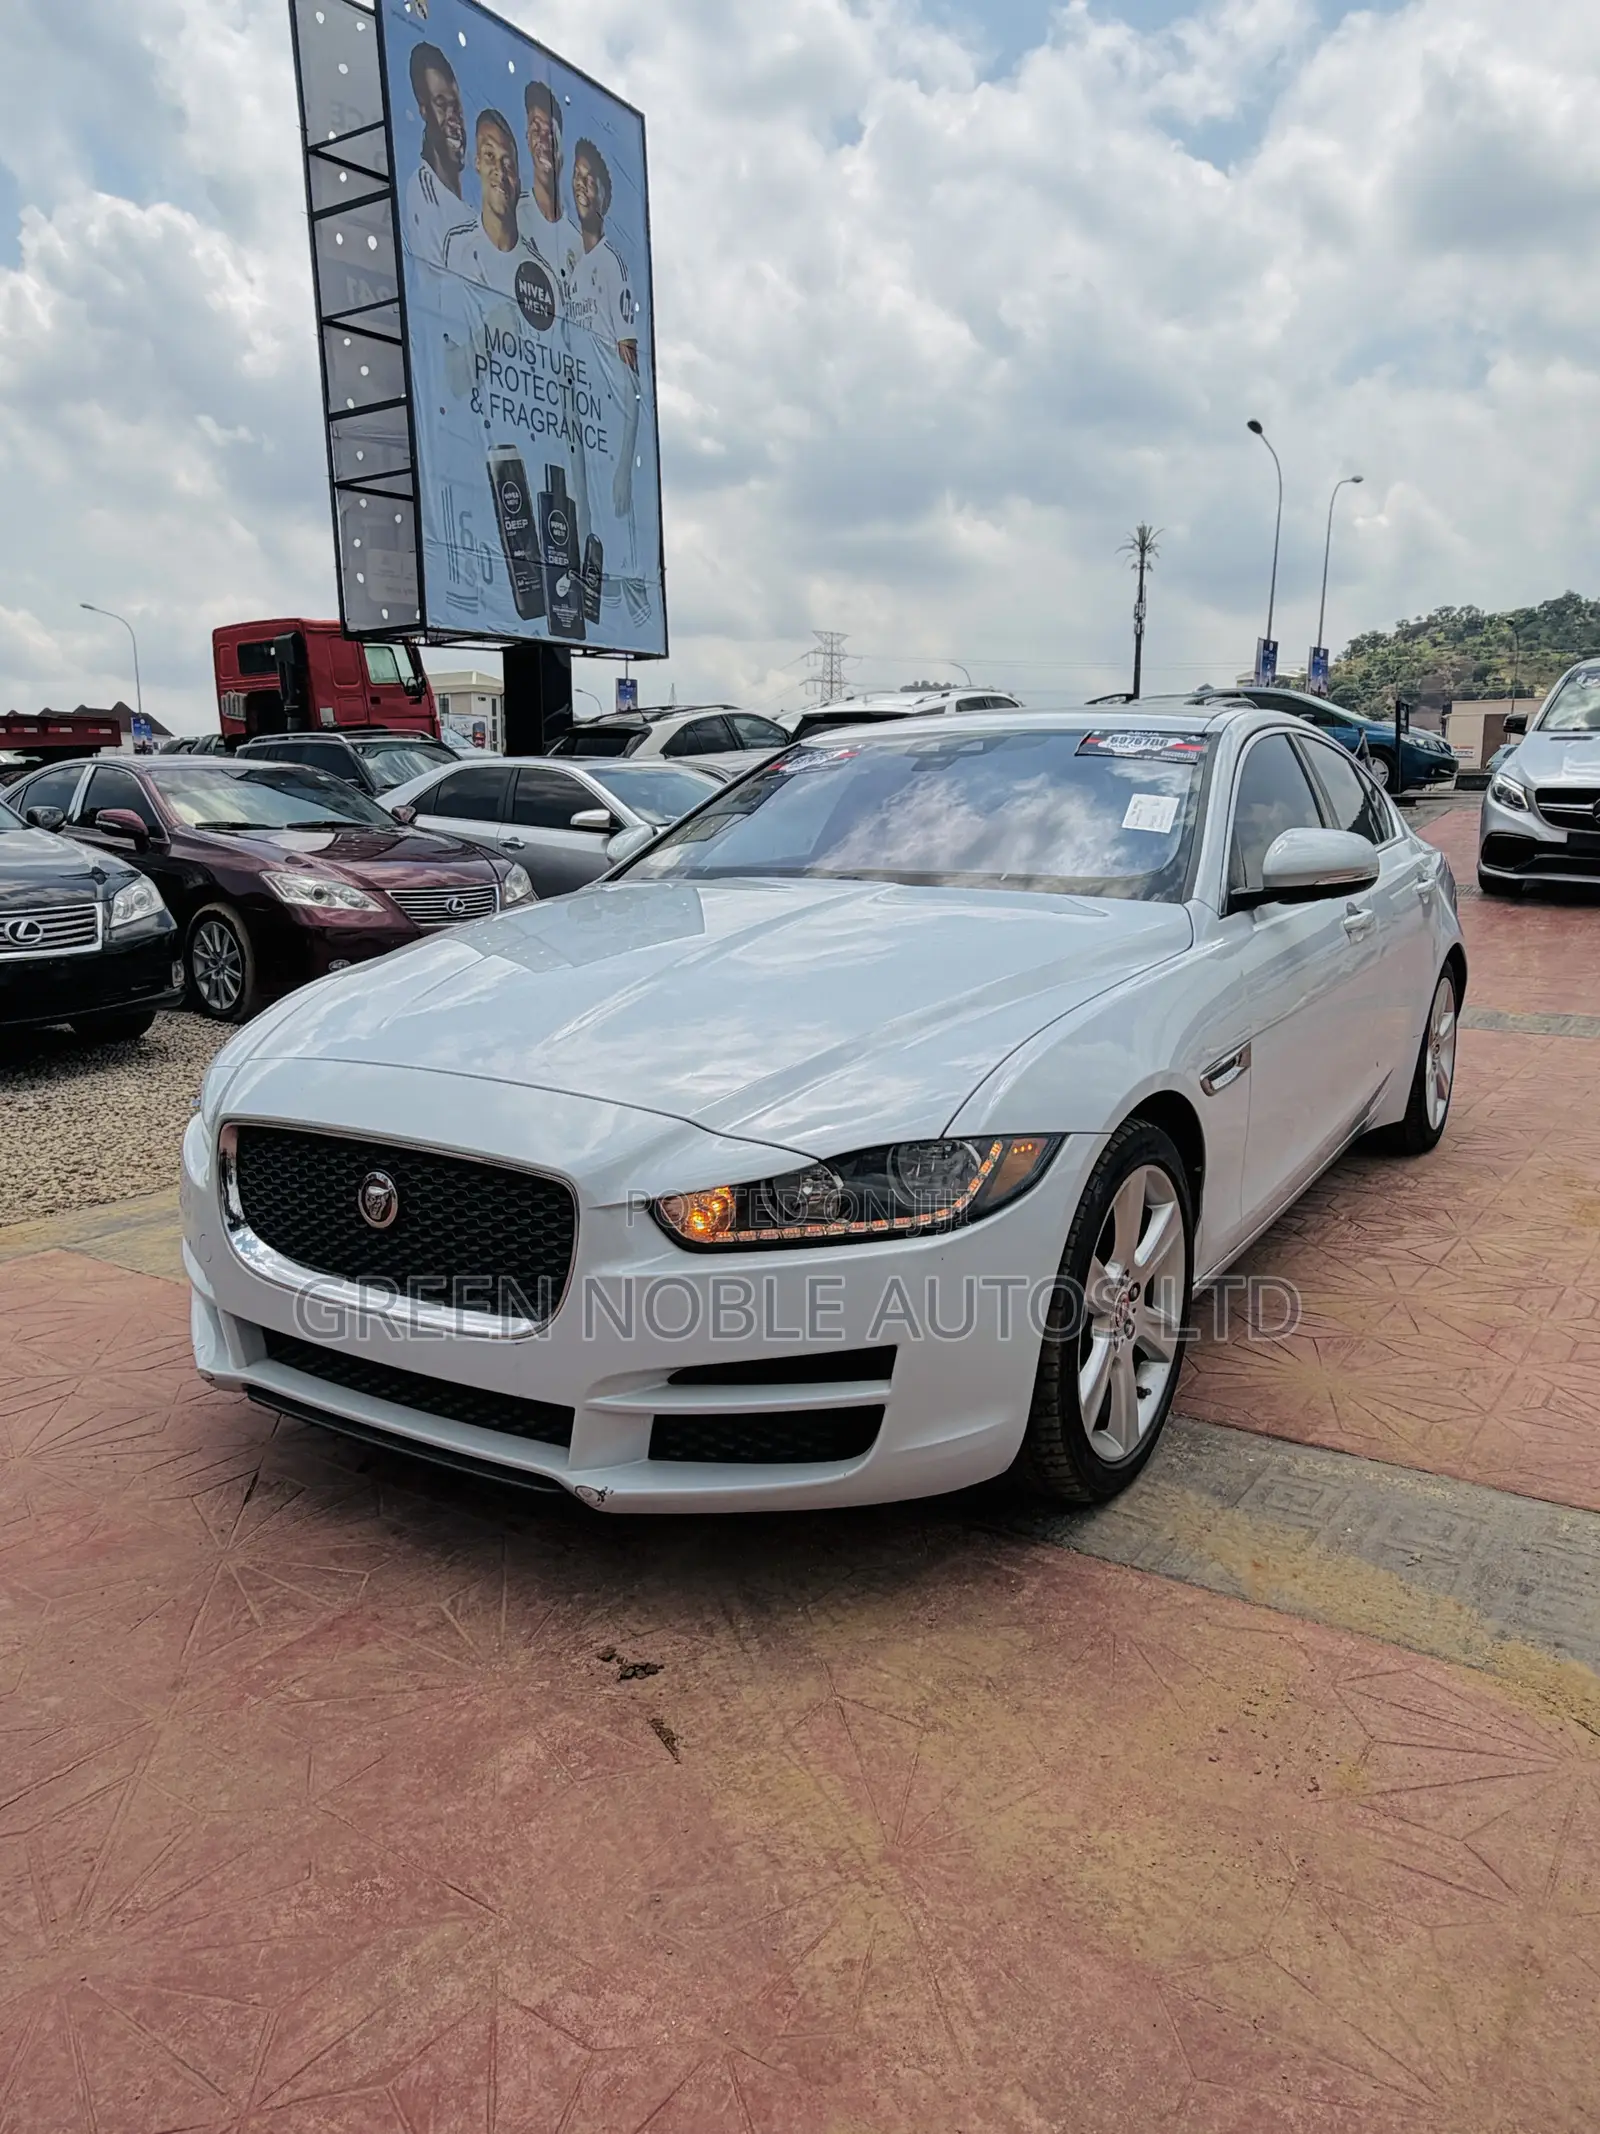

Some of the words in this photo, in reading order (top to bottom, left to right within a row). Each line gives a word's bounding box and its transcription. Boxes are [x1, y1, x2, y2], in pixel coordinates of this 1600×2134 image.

[519, 278, 552, 306] NIVEA
[524, 297, 548, 317] MEN
[484, 323, 593, 391] MOISTURE,
[470, 387, 484, 415] &
[475, 353, 602, 421] PROTECTION
[504, 518, 529, 530] DEEP
[548, 555, 570, 566] DEEP
